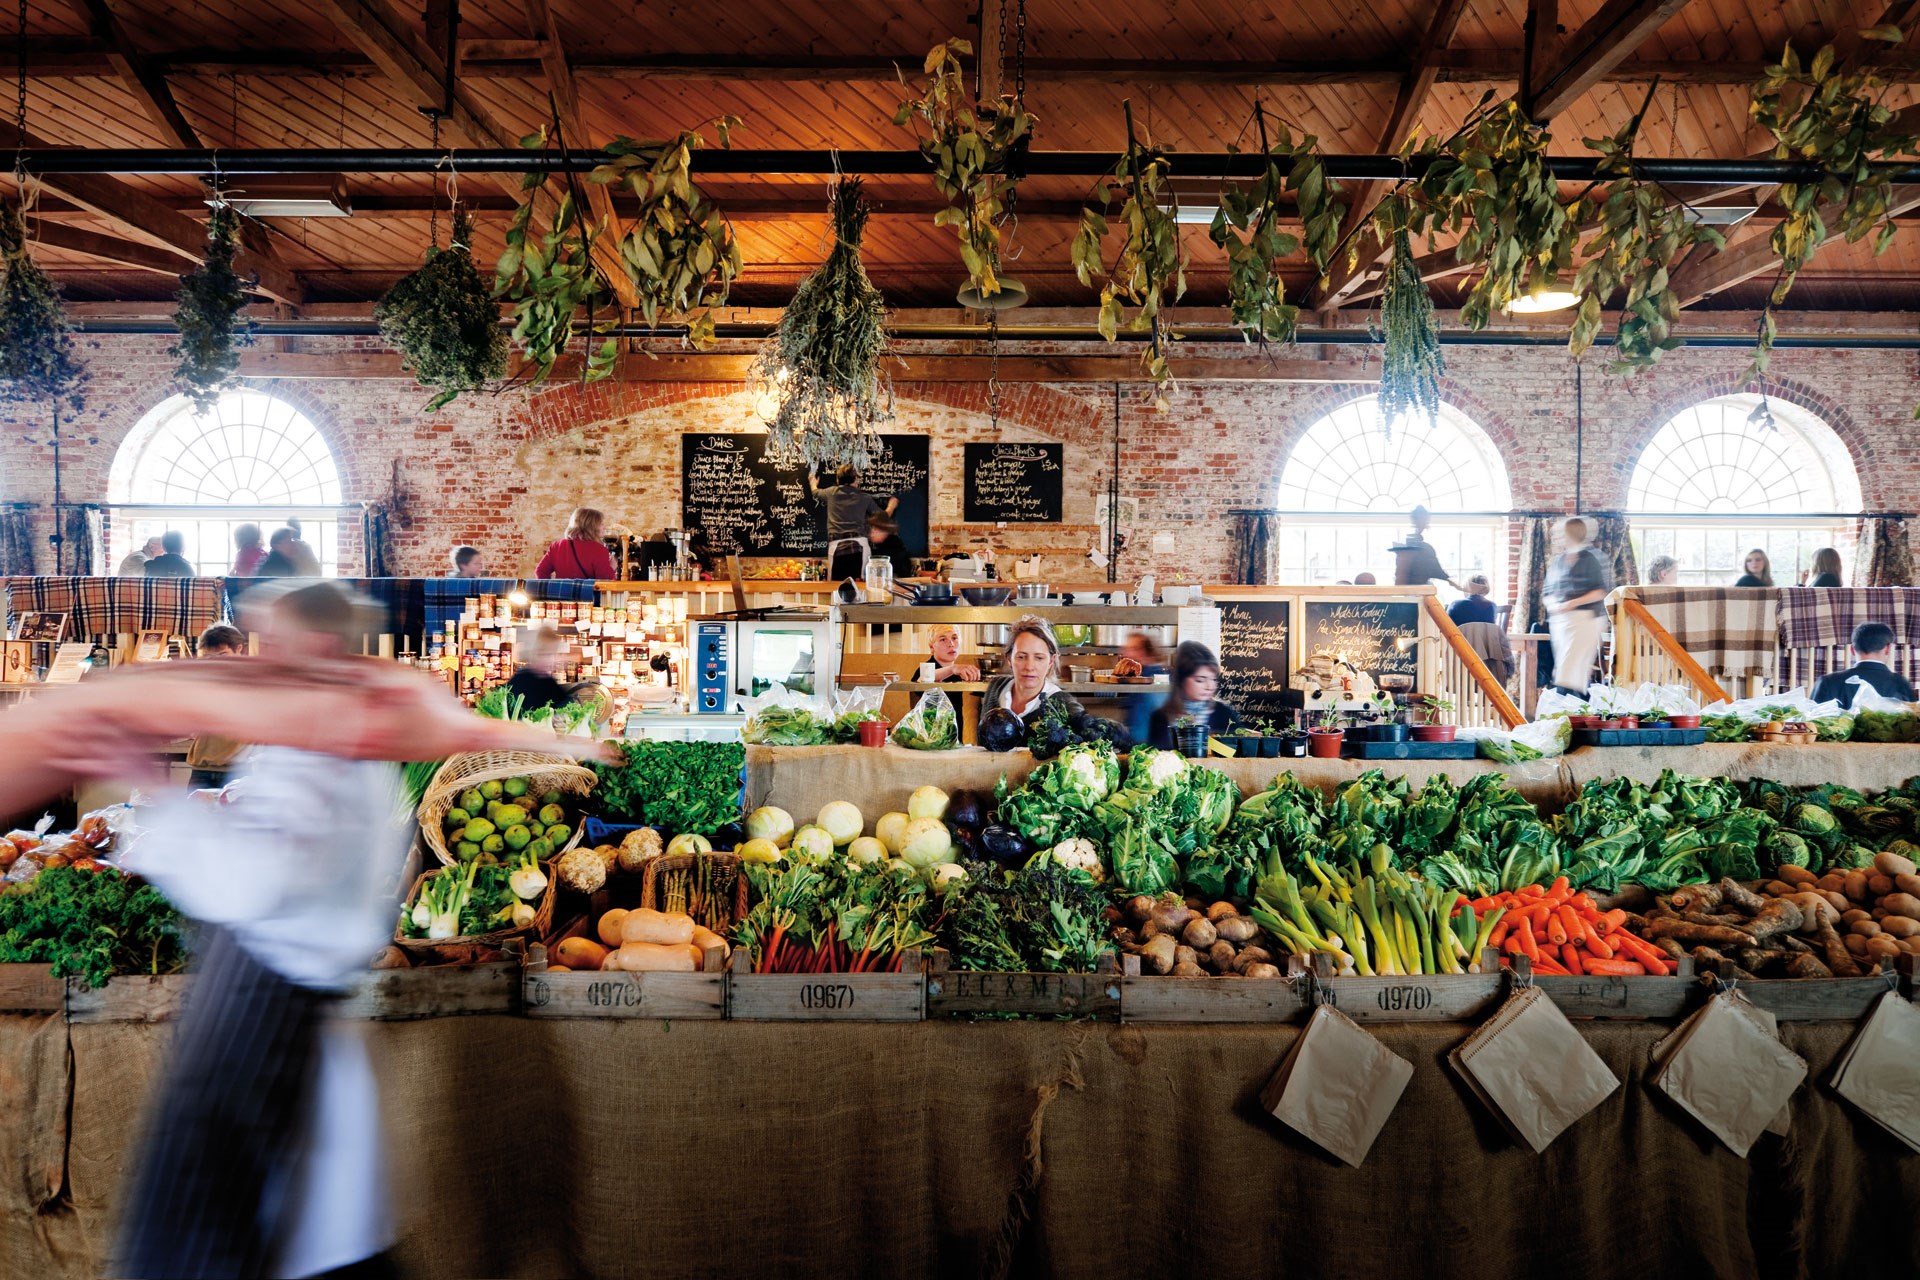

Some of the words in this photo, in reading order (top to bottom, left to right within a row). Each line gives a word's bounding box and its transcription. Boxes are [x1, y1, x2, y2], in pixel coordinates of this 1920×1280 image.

[694, 454, 712, 464] Juice
[992, 444, 1012, 457] Juice
[1361, 603, 1389, 623] Today!
[800, 984, 855, 1009] (1967)
[1378, 986, 1431, 1011] (1970)
